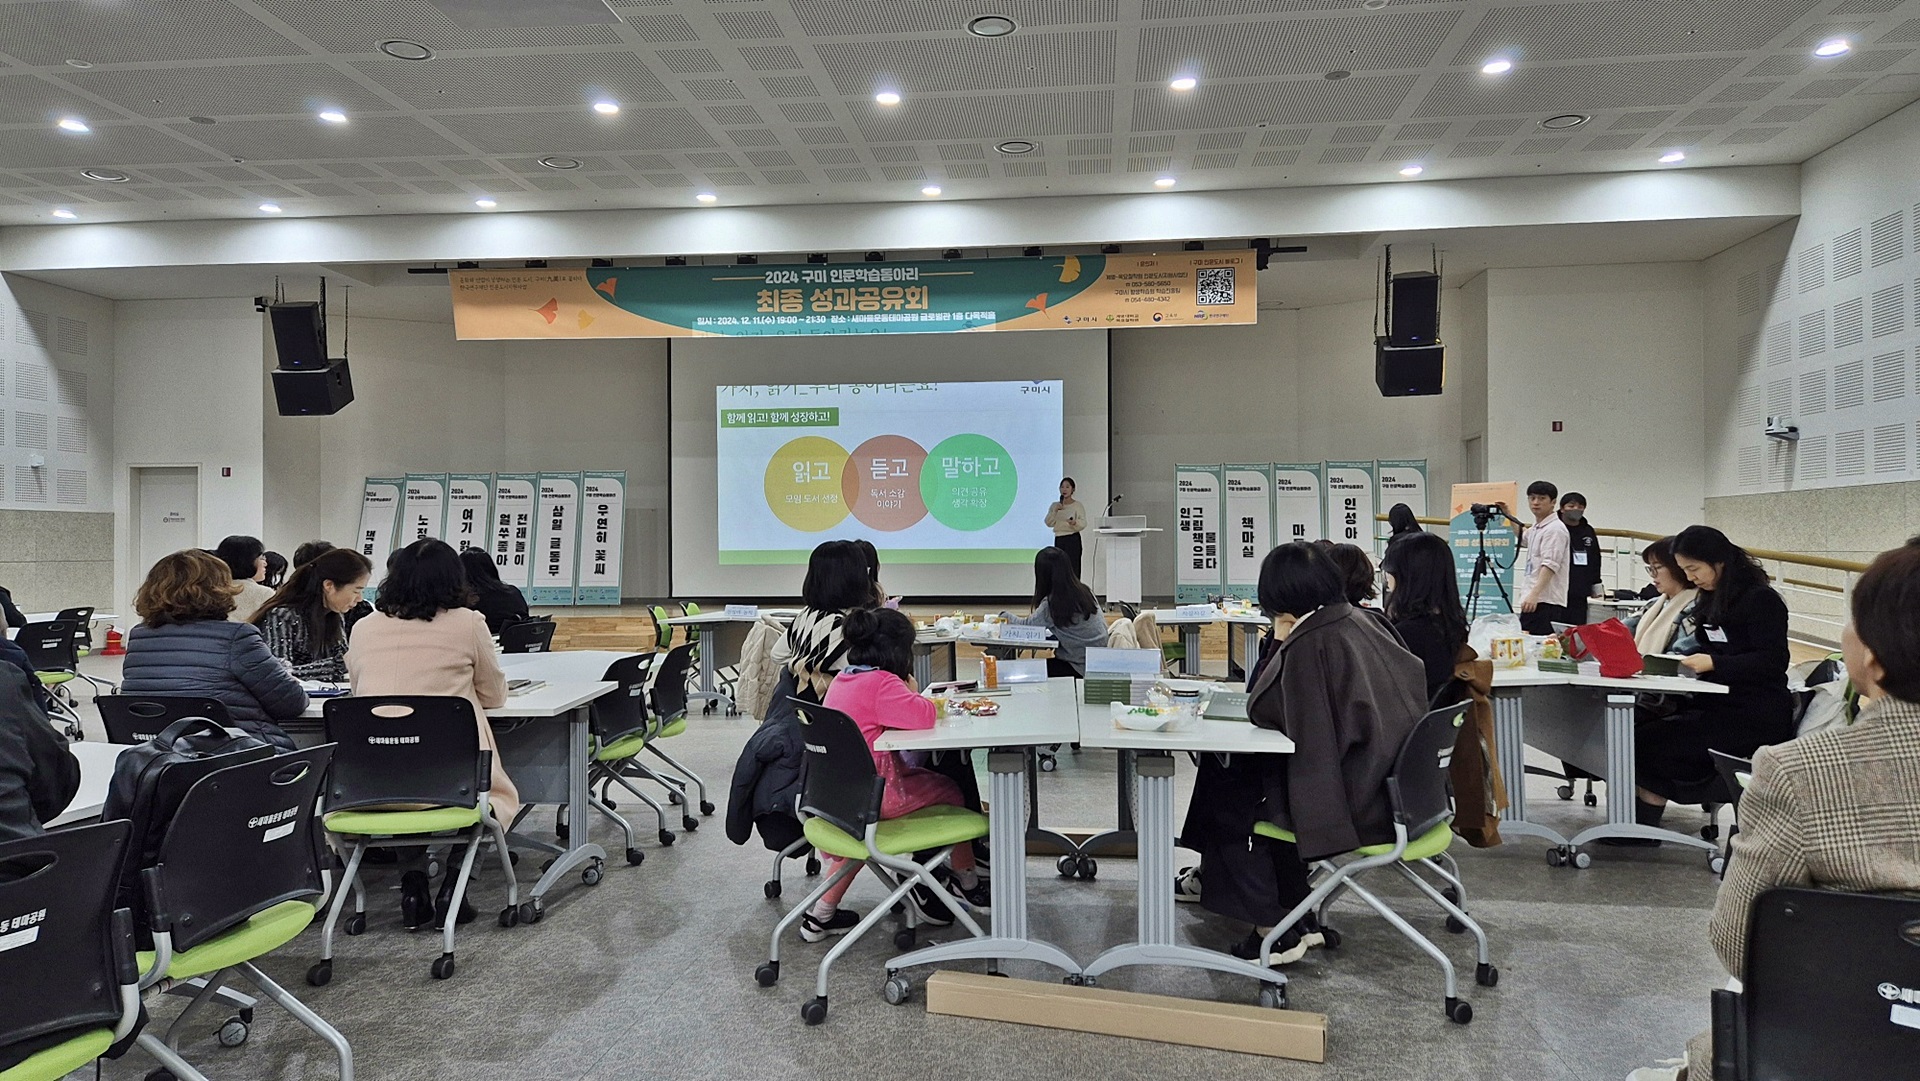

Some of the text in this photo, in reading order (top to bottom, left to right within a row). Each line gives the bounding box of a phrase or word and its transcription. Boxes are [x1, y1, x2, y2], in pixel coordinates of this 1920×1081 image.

[765, 267, 919, 284] 2024 구미 인문학습동아리
[756, 285, 929, 313] 최종 성과공유회
[776, 316, 798, 324] 19:00
[805, 315, 826, 324] 21:30
[1020, 386, 1051, 394] 구미시
[726, 411, 830, 424] 함께 읽고! 함께 성장하고!
[793, 461, 831, 483] 읽고
[870, 458, 909, 480] 듣고
[942, 457, 1001, 478] 말하고
[803, 494, 820, 503] 도서
[821, 494, 838, 503] 선정
[871, 488, 905, 498] 독서 소감
[952, 487, 987, 497] 의견 공유
[877, 500, 902, 509] 이야기
[952, 499, 968, 508] 생각
[461, 508, 474, 534] 여기
[552, 505, 565, 531] 삼일
[1180, 507, 1191, 532] 인생
[514, 514, 528, 566] 전래놀이
[594, 504, 609, 575] 우연히 꽃씨
[1192, 507, 1204, 570] 그림책으로
[1242, 517, 1255, 558] 책마실
[1205, 532, 1217, 569] 물들다
[11, 908, 47, 929] 테마공원
